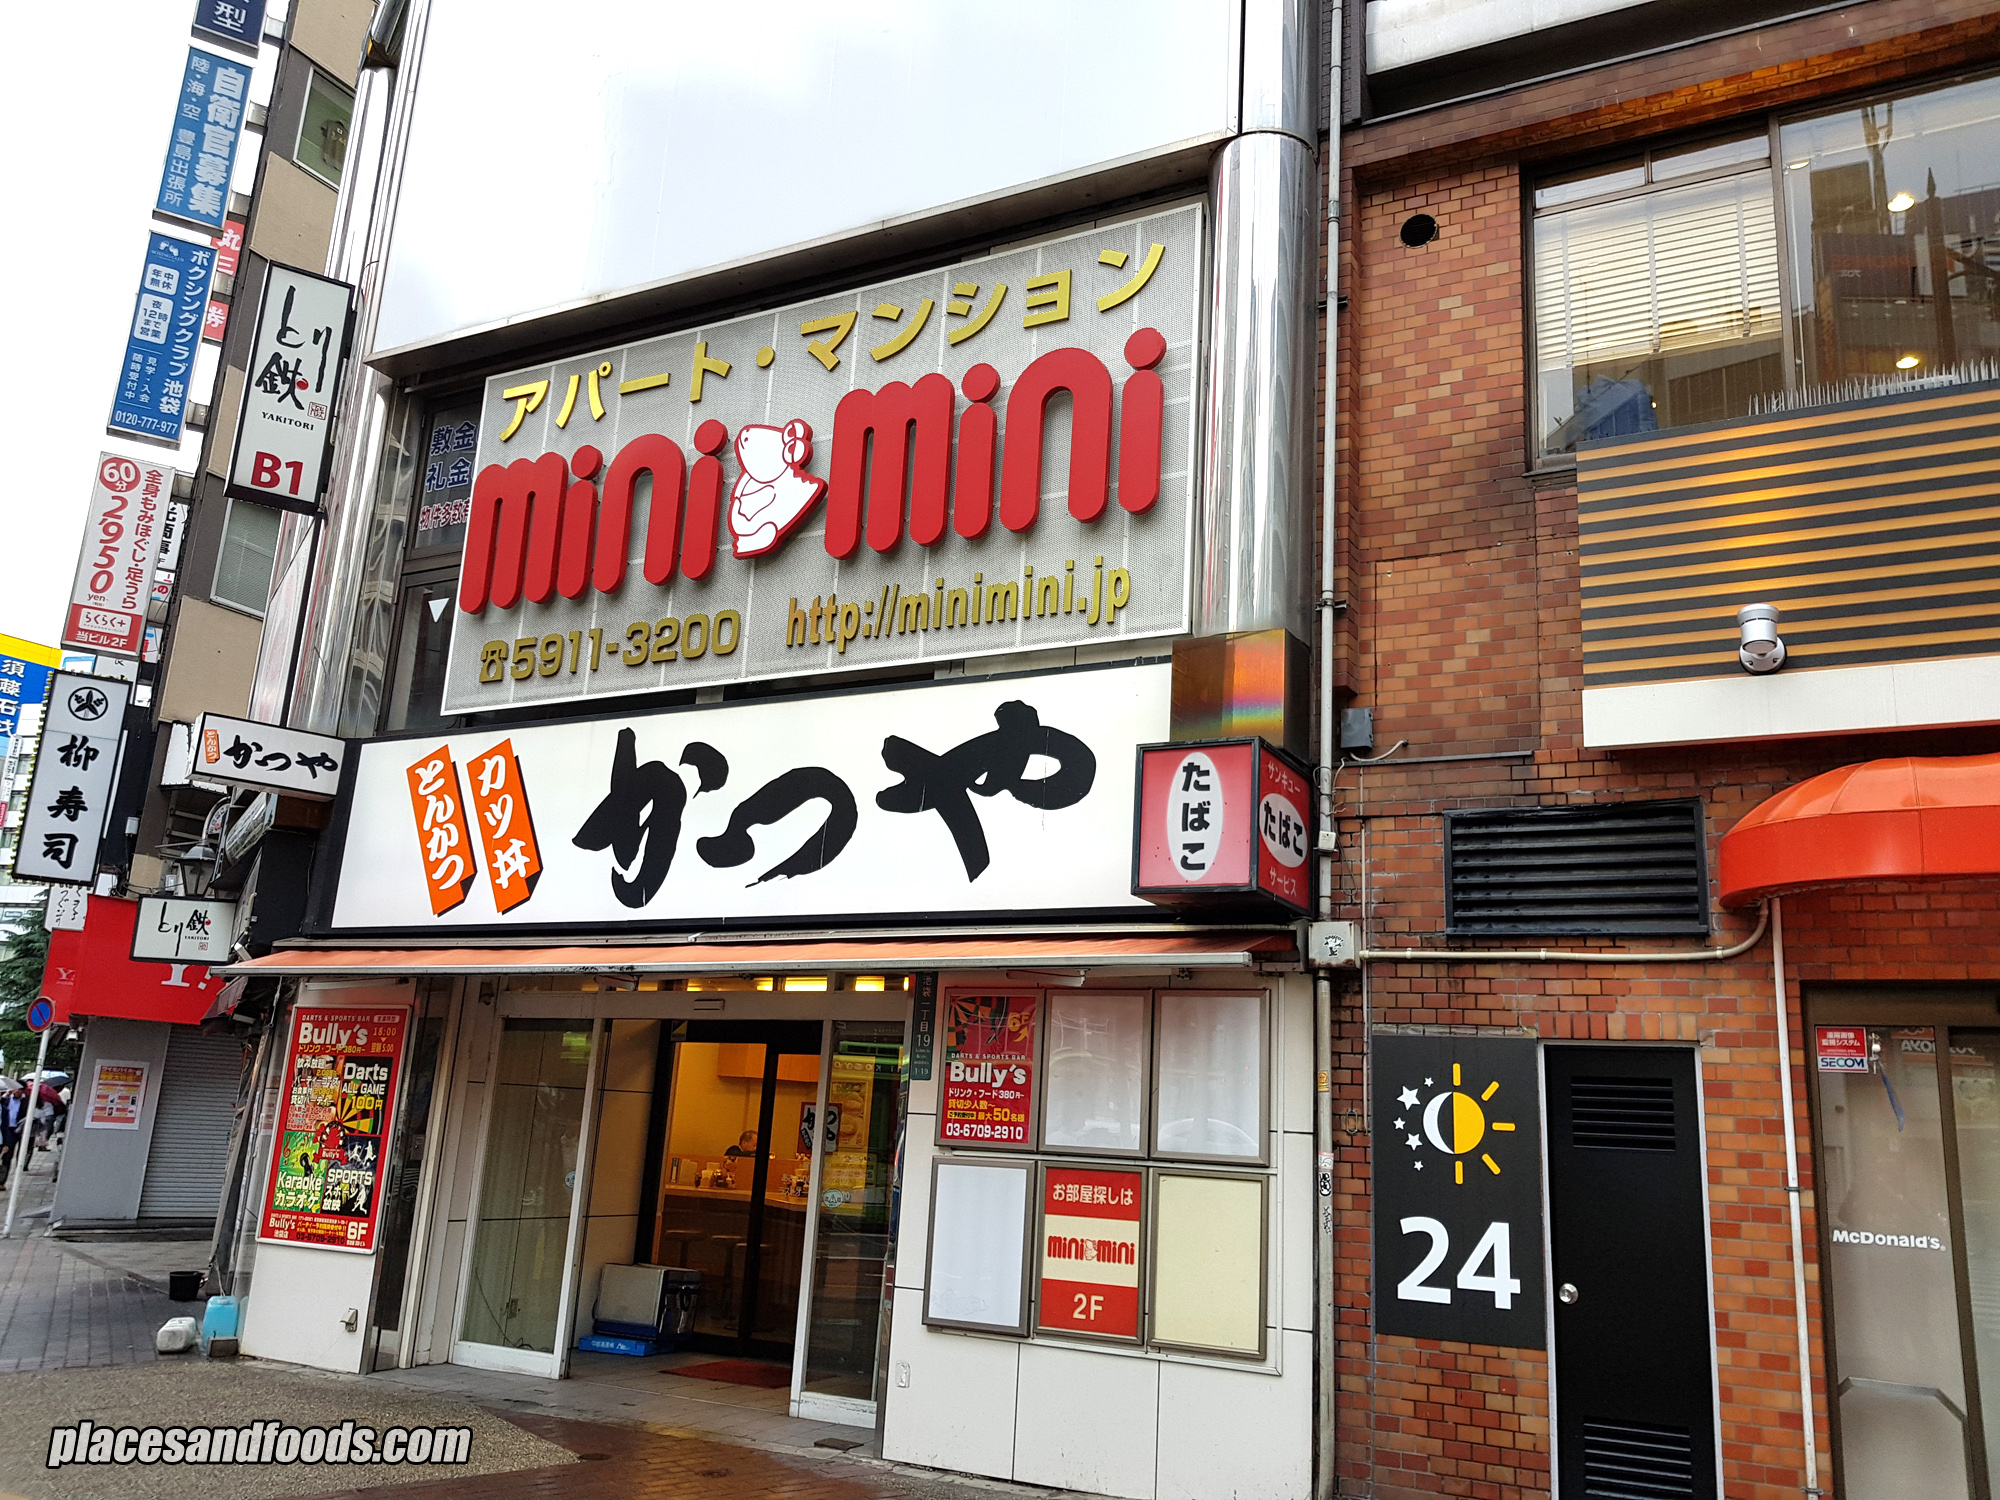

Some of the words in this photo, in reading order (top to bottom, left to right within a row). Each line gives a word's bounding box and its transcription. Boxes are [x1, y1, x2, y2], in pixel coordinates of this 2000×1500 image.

[213, 0, 249, 33] 型
[187, 66, 246, 218] 自衛官募集
[163, 128, 197, 207] 豊島出張所
[216, 229, 241, 276] 丸三
[149, 277, 173, 290] 無休
[151, 268, 175, 281] 年中
[143, 307, 168, 322] 12時
[151, 299, 162, 310] 夜
[139, 326, 162, 340] 営業
[143, 318, 162, 329] まで
[498, 242, 1166, 442] アパート・マンション
[114, 410, 179, 435] 0120-777-977
[261, 411, 315, 431] YAKITORI
[430, 420, 480, 456] 敷金
[103, 462, 136, 483] 60
[250, 450, 304, 496] B1
[425, 457, 476, 493] 礼金
[460, 418, 729, 615] mini
[824, 326, 1167, 560] mini
[115, 480, 128, 491] 分
[121, 469, 164, 611] 全身もみほぐし・足うら
[785, 553, 1130, 654] http://minimini.jp
[511, 609, 741, 679] 5911-3200
[206, 730, 218, 760] とんかつ
[223, 735, 338, 779] かつや
[1268, 761, 1301, 794] サンキュー
[42, 735, 100, 869] 柳寿司
[571, 700, 1097, 909] かつや
[414, 753, 466, 891] とんかつ
[477, 752, 527, 889] カツ丼
[1180, 762, 1211, 871] たばこ
[1263, 800, 1304, 858] たばこ
[1269, 866, 1297, 897] サービス
[921, 971, 932, 1032] 池袋一丁目
[298, 1022, 369, 1049] Bully's
[1008, 1012, 1031, 1032] 6F
[917, 1034, 931, 1047] 19
[343, 1062, 389, 1081] Darts
[950, 1061, 1027, 1088] Bully's
[1820, 1057, 1865, 1068] SECOM
[342, 1083, 358, 1094] ALL
[360, 1083, 386, 1095] GAME
[351, 1095, 384, 1111] 100円
[978, 1108, 1025, 1122] 最大50名様
[946, 1123, 1024, 1140] 03-6709-2910
[276, 1171, 322, 1191] Karaoke
[327, 1168, 373, 1186] SPORTS
[275, 1190, 320, 1209] カラオケ
[325, 1184, 359, 1199] スポーツ
[1052, 1183, 1134, 1206] お部屋探しは
[269, 1217, 296, 1230] Bully's
[347, 1221, 369, 1240] 6F
[296, 1232, 346, 1245] 03-6709-2910
[1047, 1235, 1085, 1261] mini
[1096, 1239, 1135, 1265] mini
[1832, 1229, 1942, 1250] McDonald's
[1397, 1216, 1521, 1310] 24
[1072, 1292, 1105, 1321] 2F
